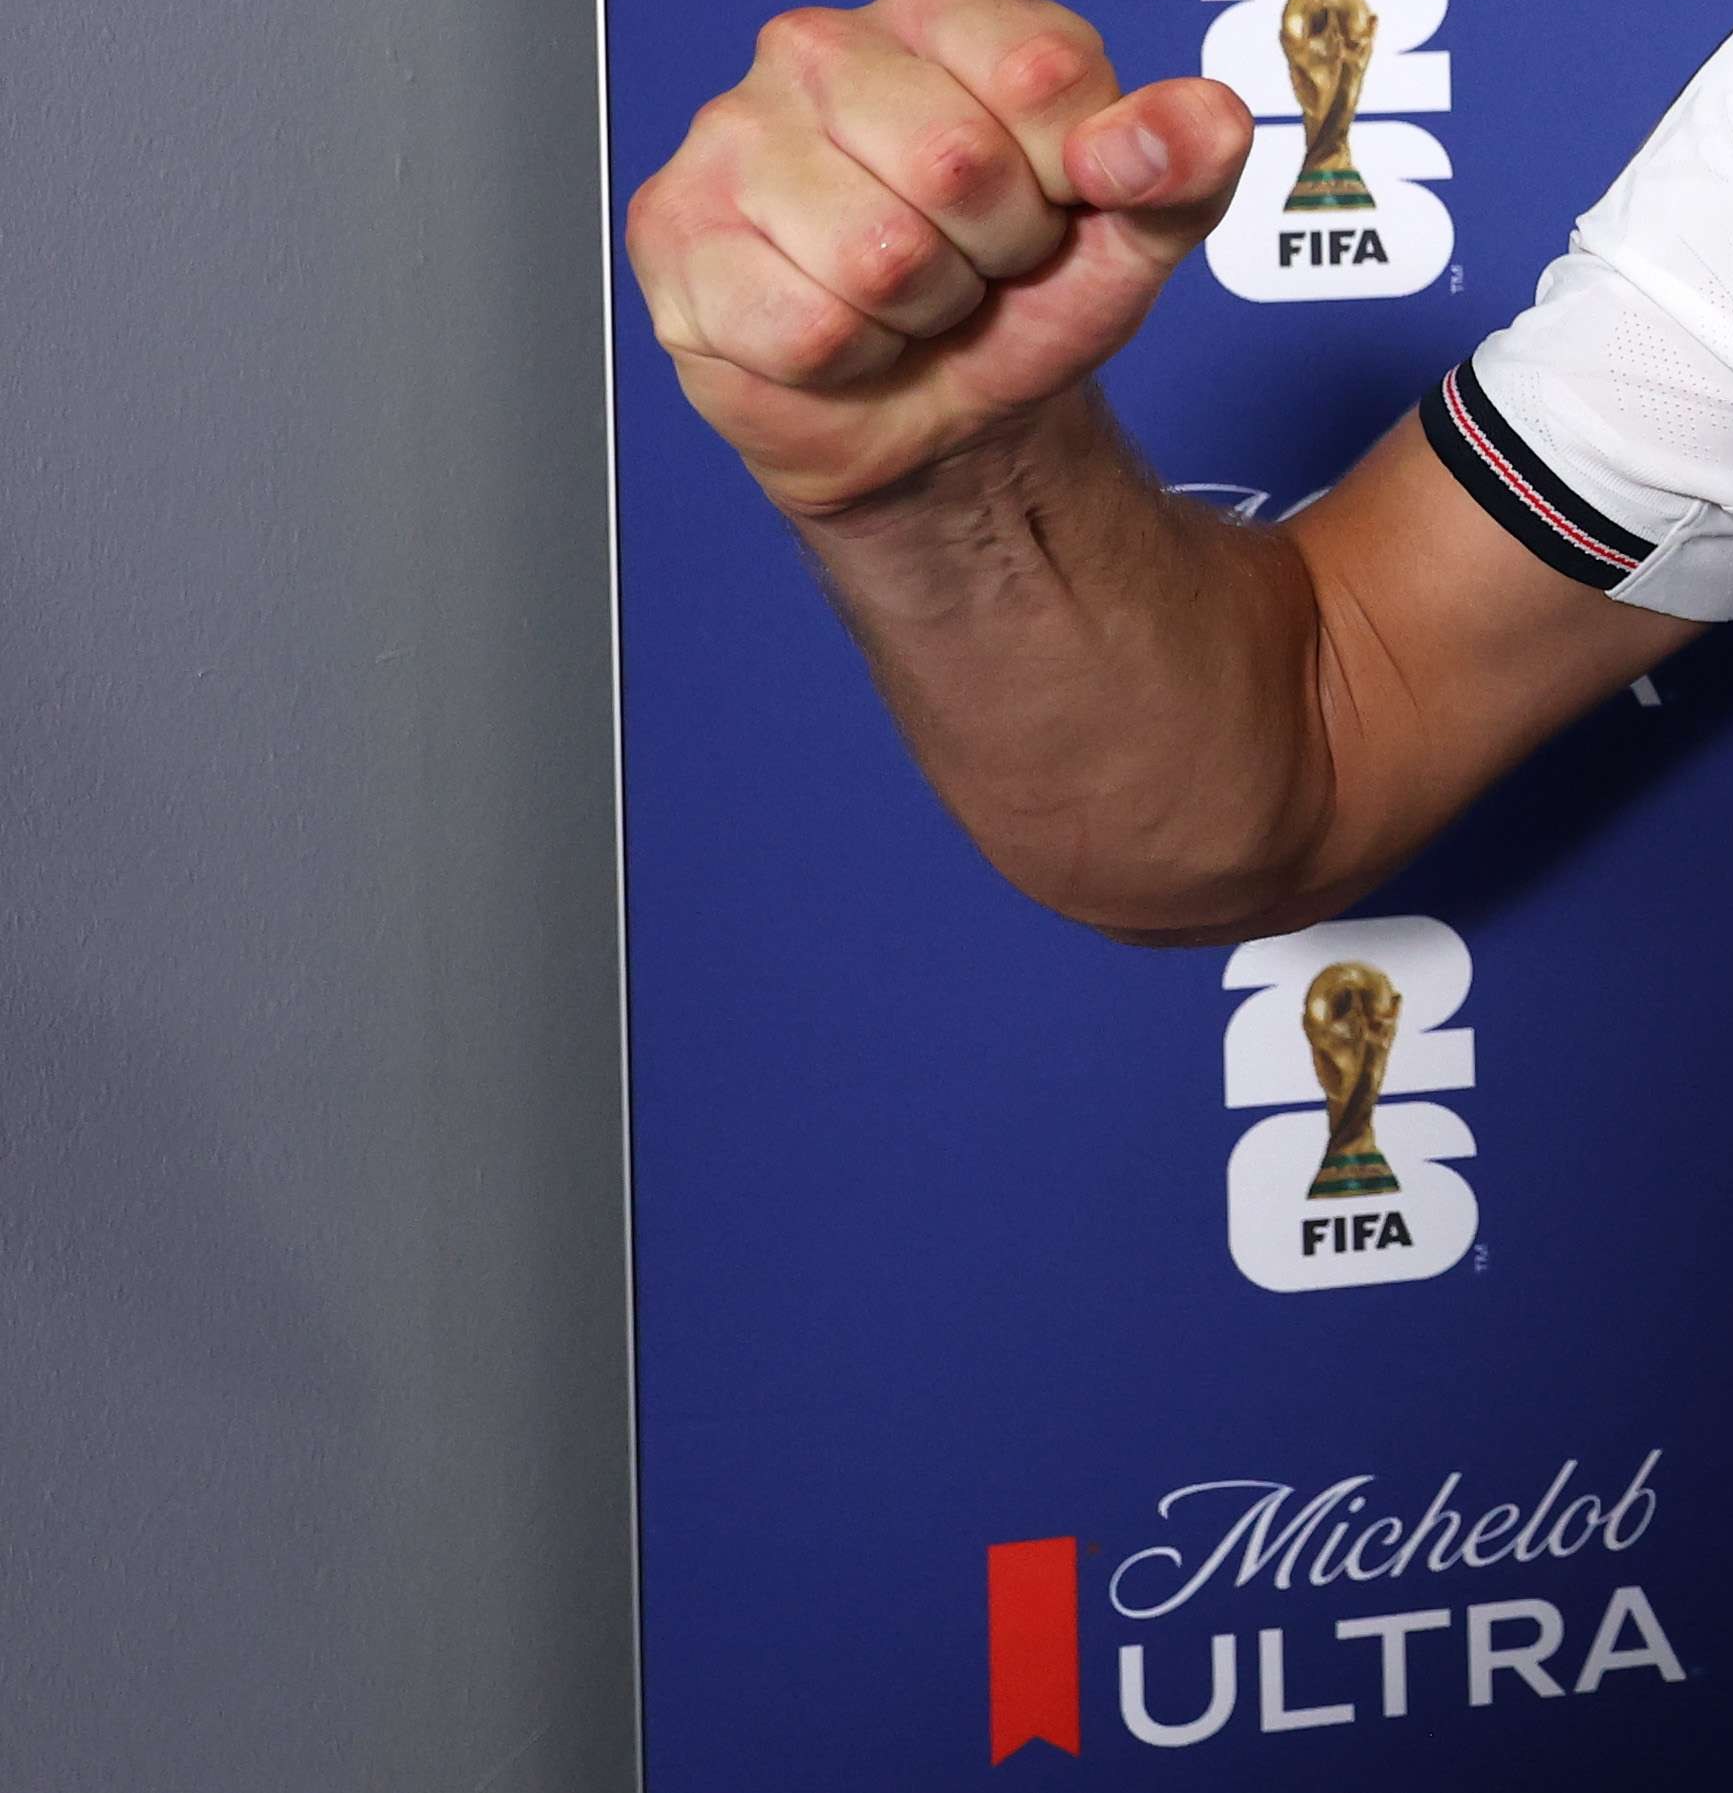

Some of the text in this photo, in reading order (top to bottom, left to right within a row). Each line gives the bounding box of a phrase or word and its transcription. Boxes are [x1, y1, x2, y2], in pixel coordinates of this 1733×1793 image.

[1278, 228, 1389, 268] FIFA
[1301, 1210, 1413, 1257] FIFA
[1110, 1448, 1662, 1619] Michelob
[1119, 1586, 1685, 1748] ULTRA
